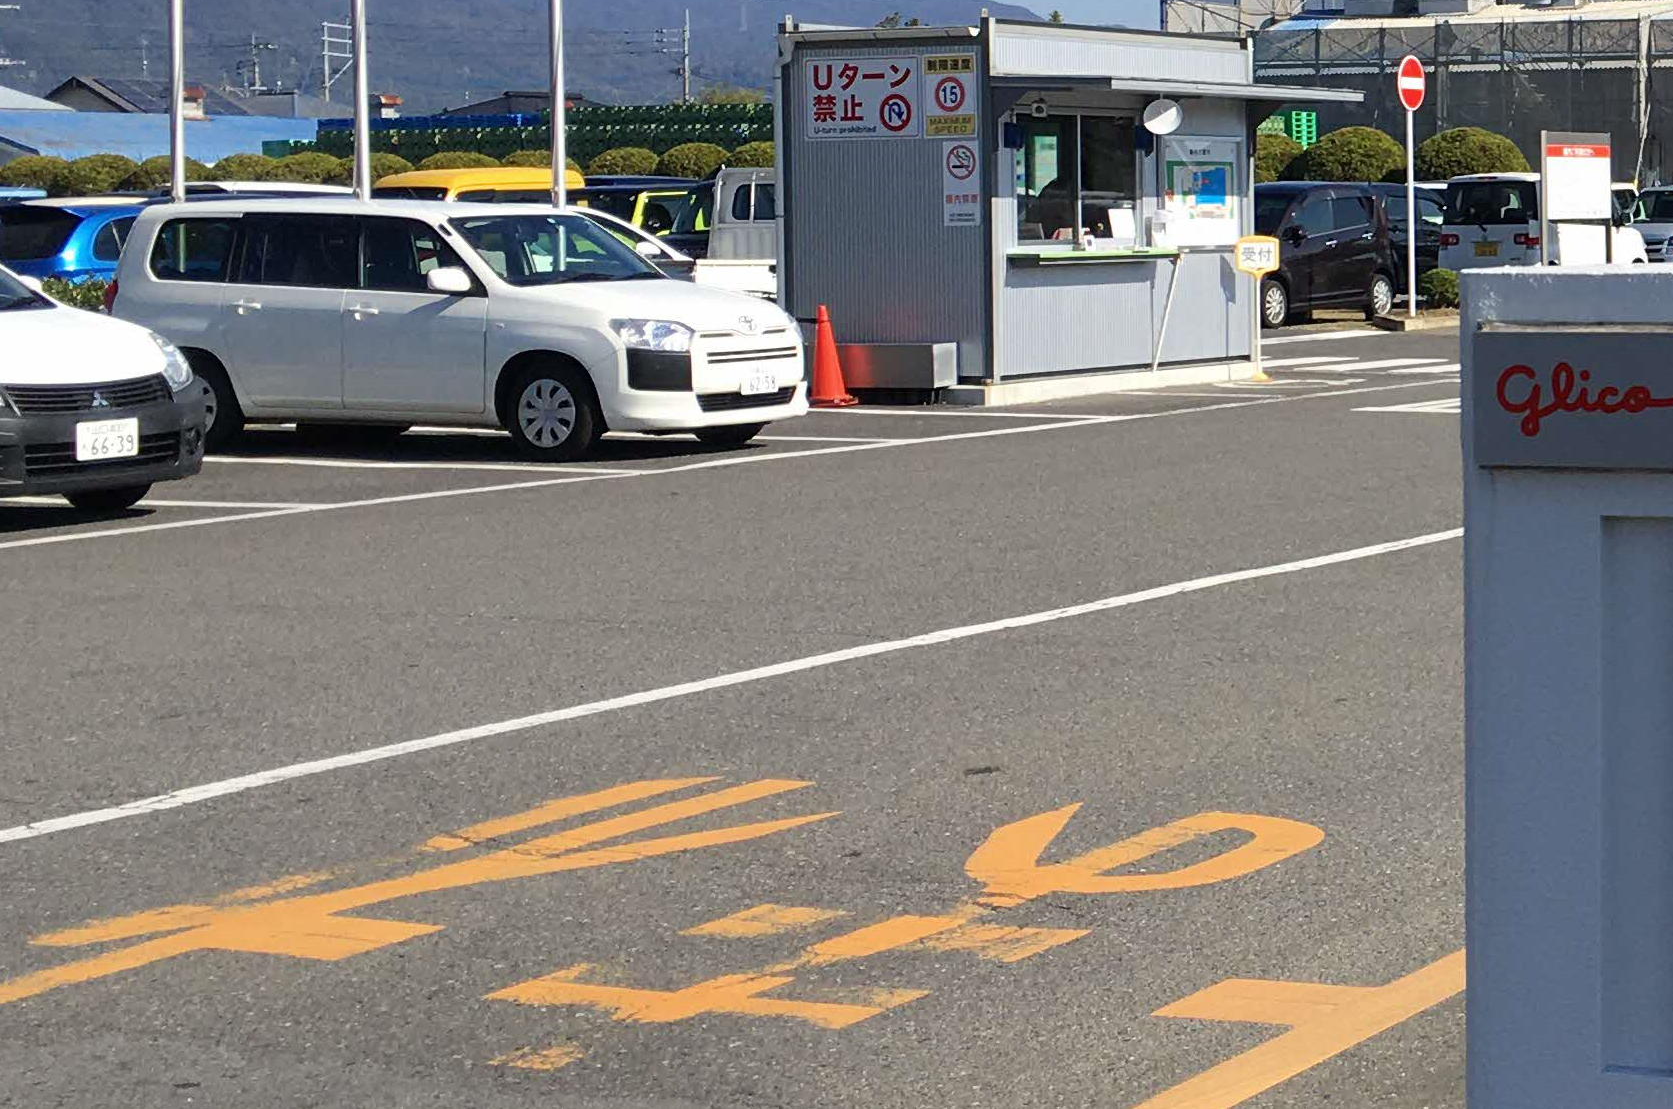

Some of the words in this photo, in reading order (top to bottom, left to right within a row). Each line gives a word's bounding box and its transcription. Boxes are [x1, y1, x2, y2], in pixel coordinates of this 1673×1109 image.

[813, 63, 911, 91] Uターン
[941, 85, 958, 104] 15
[812, 94, 864, 122] 禁止
[1241, 246, 1272, 263] 受付
